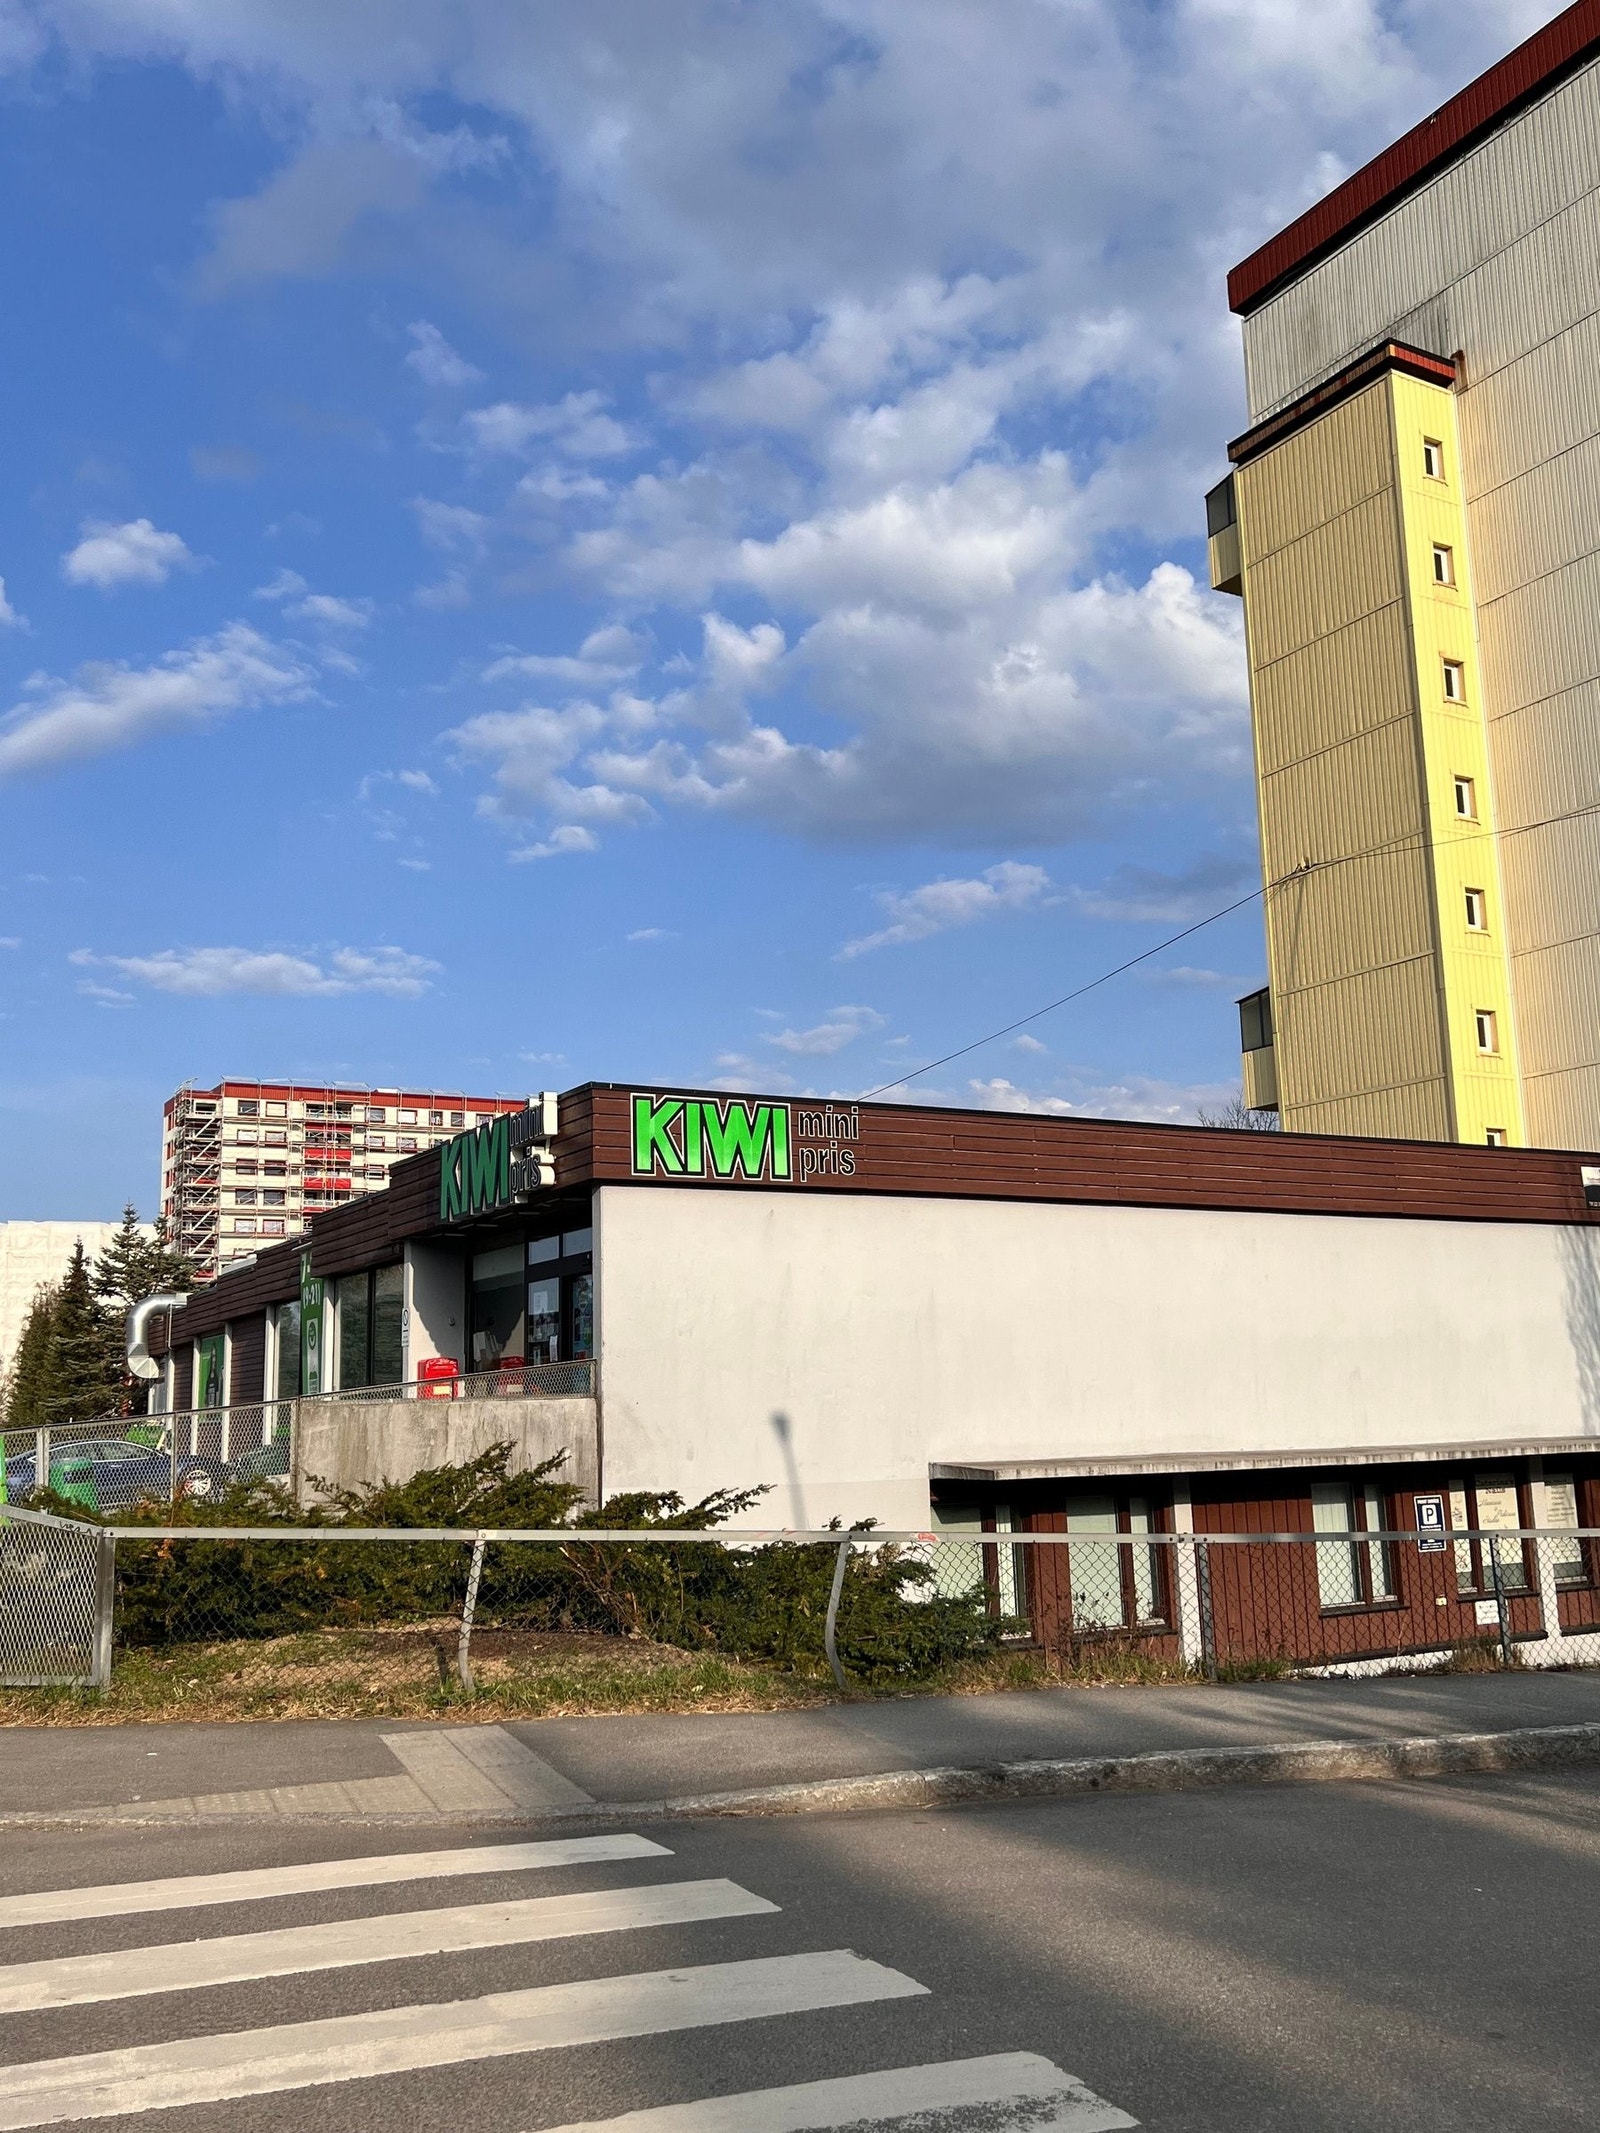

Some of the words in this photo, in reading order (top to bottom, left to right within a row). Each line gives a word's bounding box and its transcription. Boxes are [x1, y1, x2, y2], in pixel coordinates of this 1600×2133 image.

[510, 1091, 544, 1147] mini
[630, 1092, 793, 1182] KIWI
[798, 1104, 859, 1140] mini
[441, 1112, 510, 1223] KIWI
[510, 1146, 542, 1204] pris
[799, 1141, 856, 1182] pris
[1425, 1507, 1434, 1522] P
